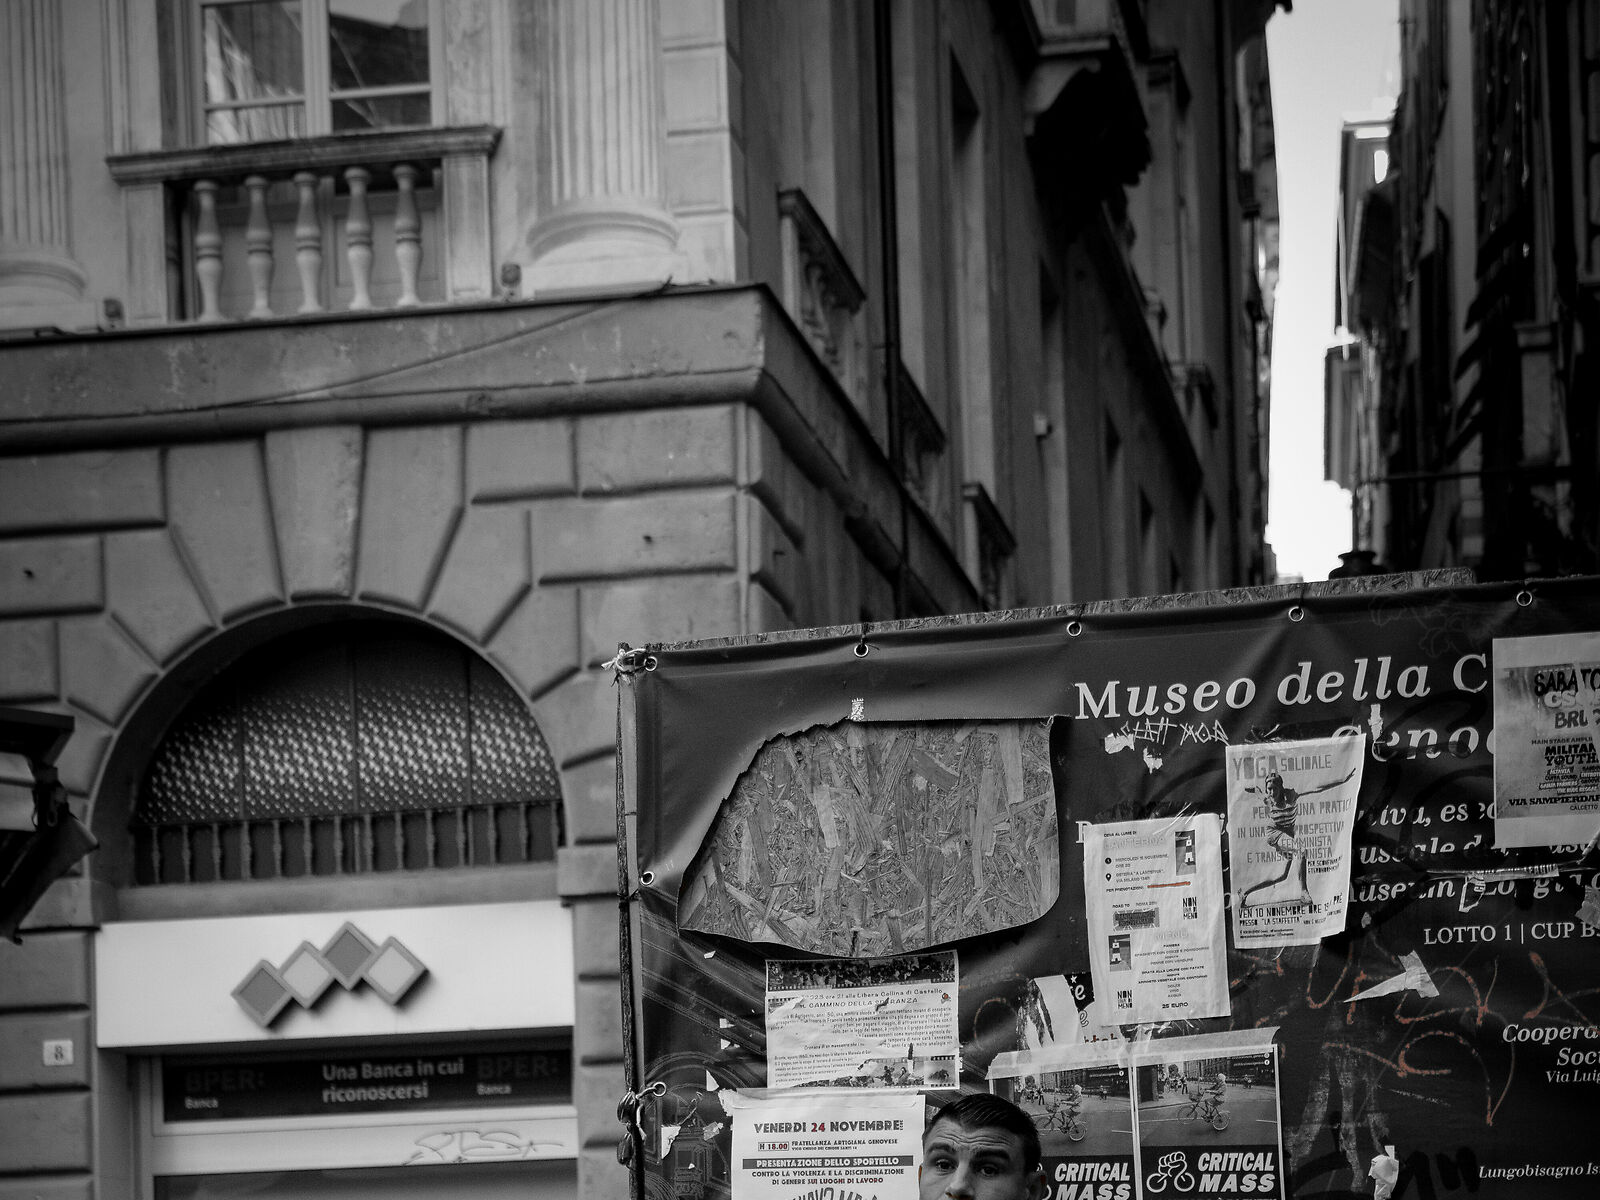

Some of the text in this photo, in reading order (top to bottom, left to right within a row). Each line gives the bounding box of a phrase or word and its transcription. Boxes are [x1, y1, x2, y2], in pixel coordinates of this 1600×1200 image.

[1074, 677, 1256, 719] Museo
[1277, 656, 1431, 705] della
[1234, 755, 1278, 780] YOGA
[1297, 802, 1315, 816] UNA
[1237, 828, 1246, 838] IN
[1249, 826, 1266, 838] UNA
[1247, 853, 1253, 863] E
[1239, 908, 1252, 918] VEN
[1256, 907, 1264, 917] 10
[1308, 904, 1322, 914] ORE
[1424, 925, 1496, 945] LOTTO
[1504, 924, 1512, 941] 1
[1531, 921, 1575, 940] CUP
[1502, 1024, 1600, 1045] Coopera
[322, 1064, 357, 1081] Una
[361, 1060, 414, 1079] Banca
[418, 1059, 435, 1076] in
[437, 1057, 465, 1075] cui
[1545, 1070, 1570, 1083] Via
[185, 1081, 513, 1109] Banca riconoscersi Banca
[754, 1120, 899, 1133] VENERDI 24 NOVEMBRE
[757, 1158, 900, 1168] PRESENTAZIONE DELLO SPORTELLO
[1054, 1162, 1131, 1182] CRITICAL
[1197, 1152, 1275, 1172] CRITICAL
[1478, 1164, 1584, 1181] Lungobisagno
[1198, 1173, 1276, 1193] MASS
